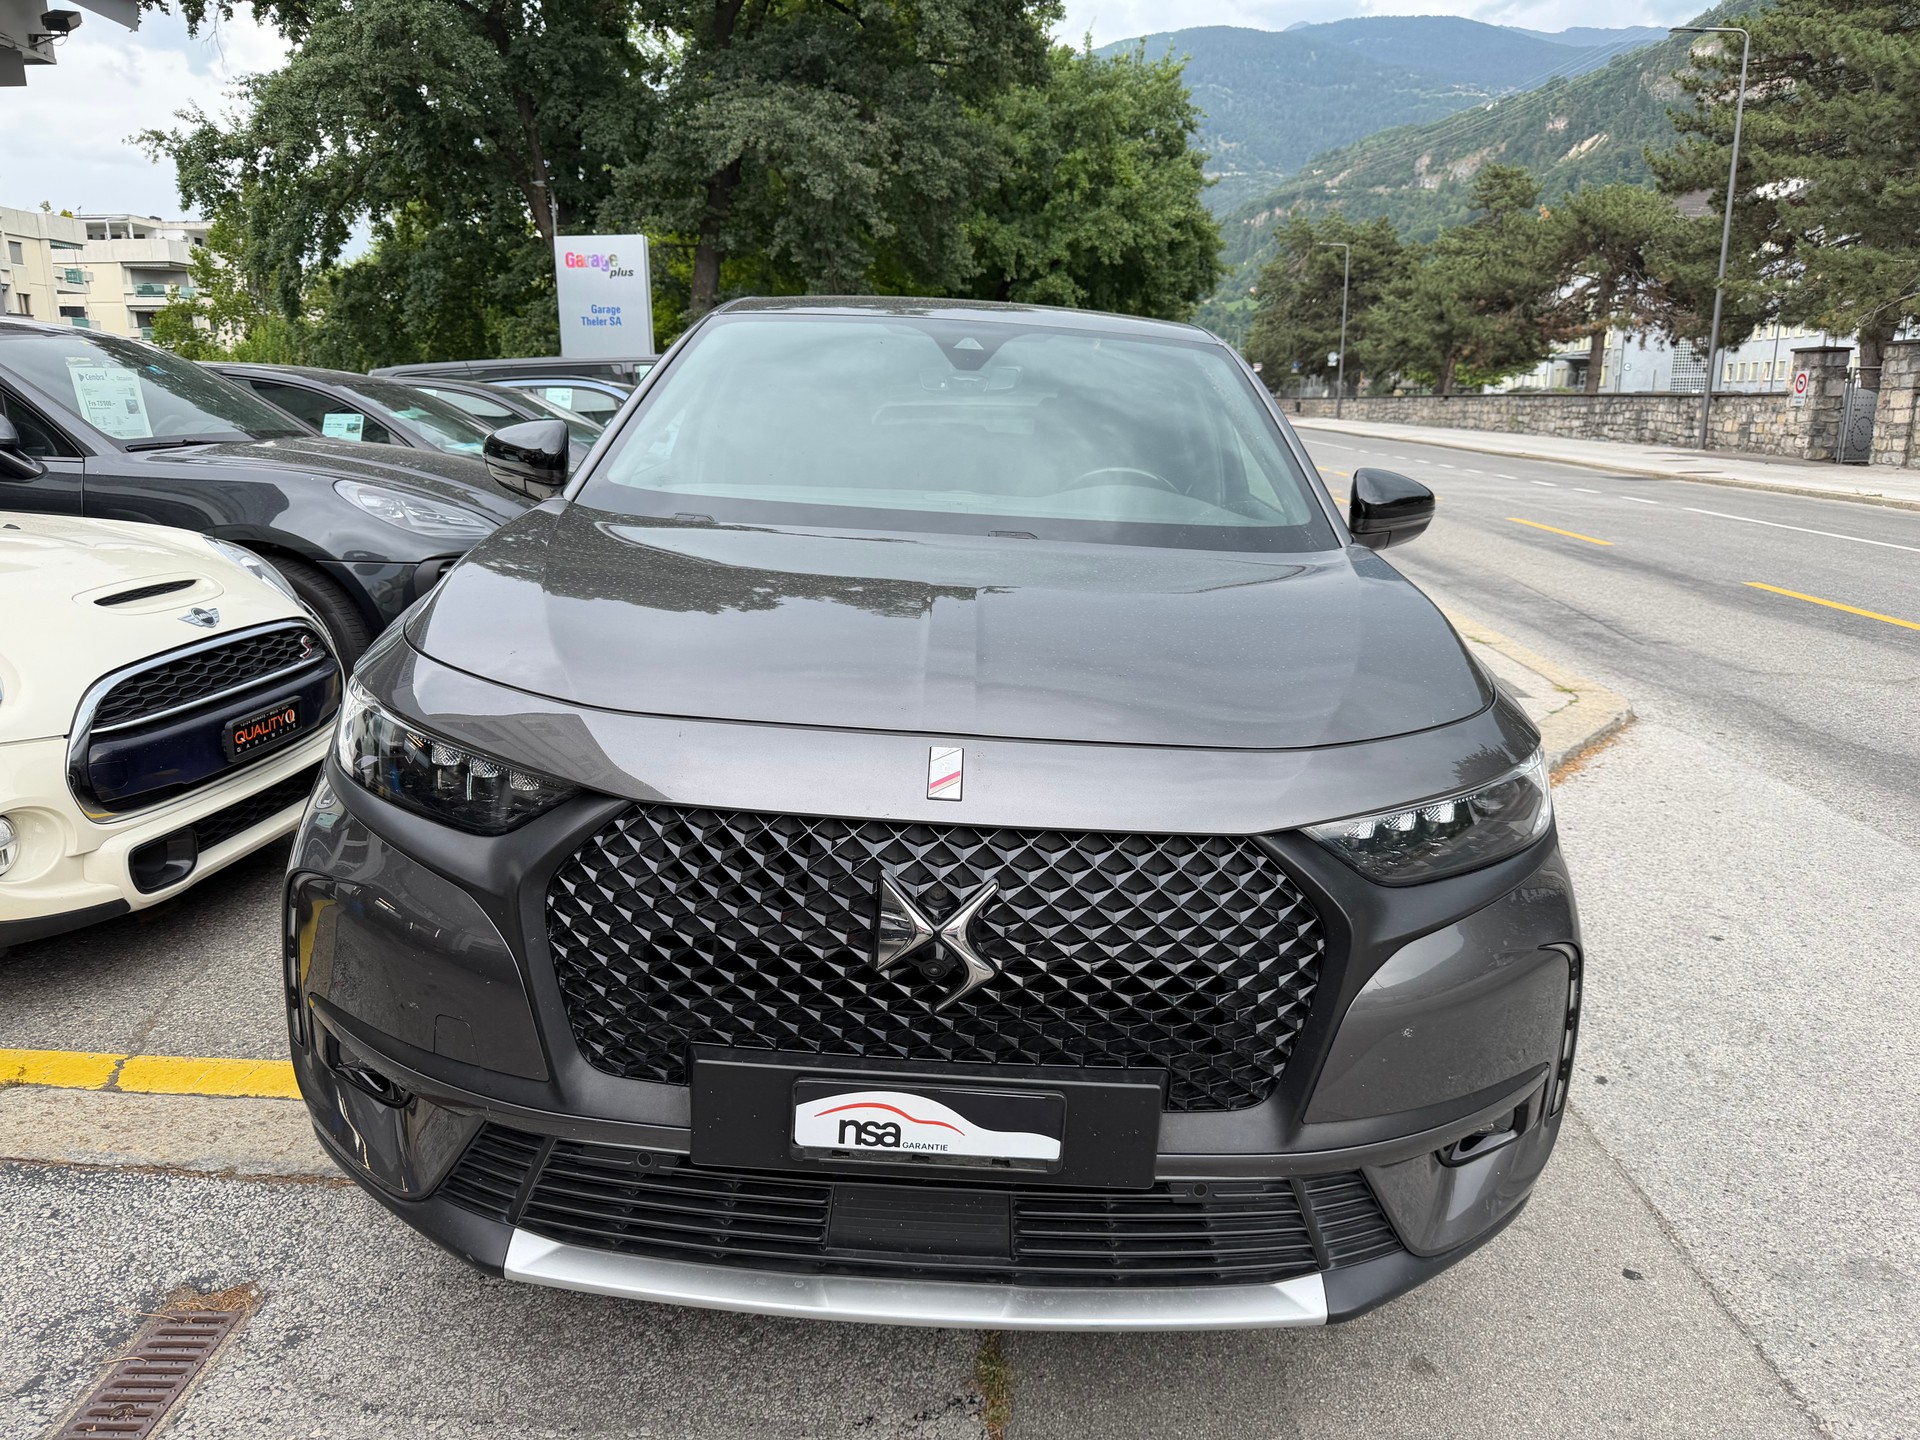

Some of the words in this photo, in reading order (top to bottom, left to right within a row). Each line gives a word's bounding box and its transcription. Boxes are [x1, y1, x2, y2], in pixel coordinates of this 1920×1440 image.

[565, 251, 619, 272] Garage
[609, 267, 634, 279] plus
[591, 304, 621, 316] Garage
[581, 316, 607, 327] Theler
[609, 316, 622, 327] SA
[237, 722, 297, 753] GARANTIE
[838, 1119, 901, 1148] nsa
[902, 1141, 949, 1152] GARANTIE
